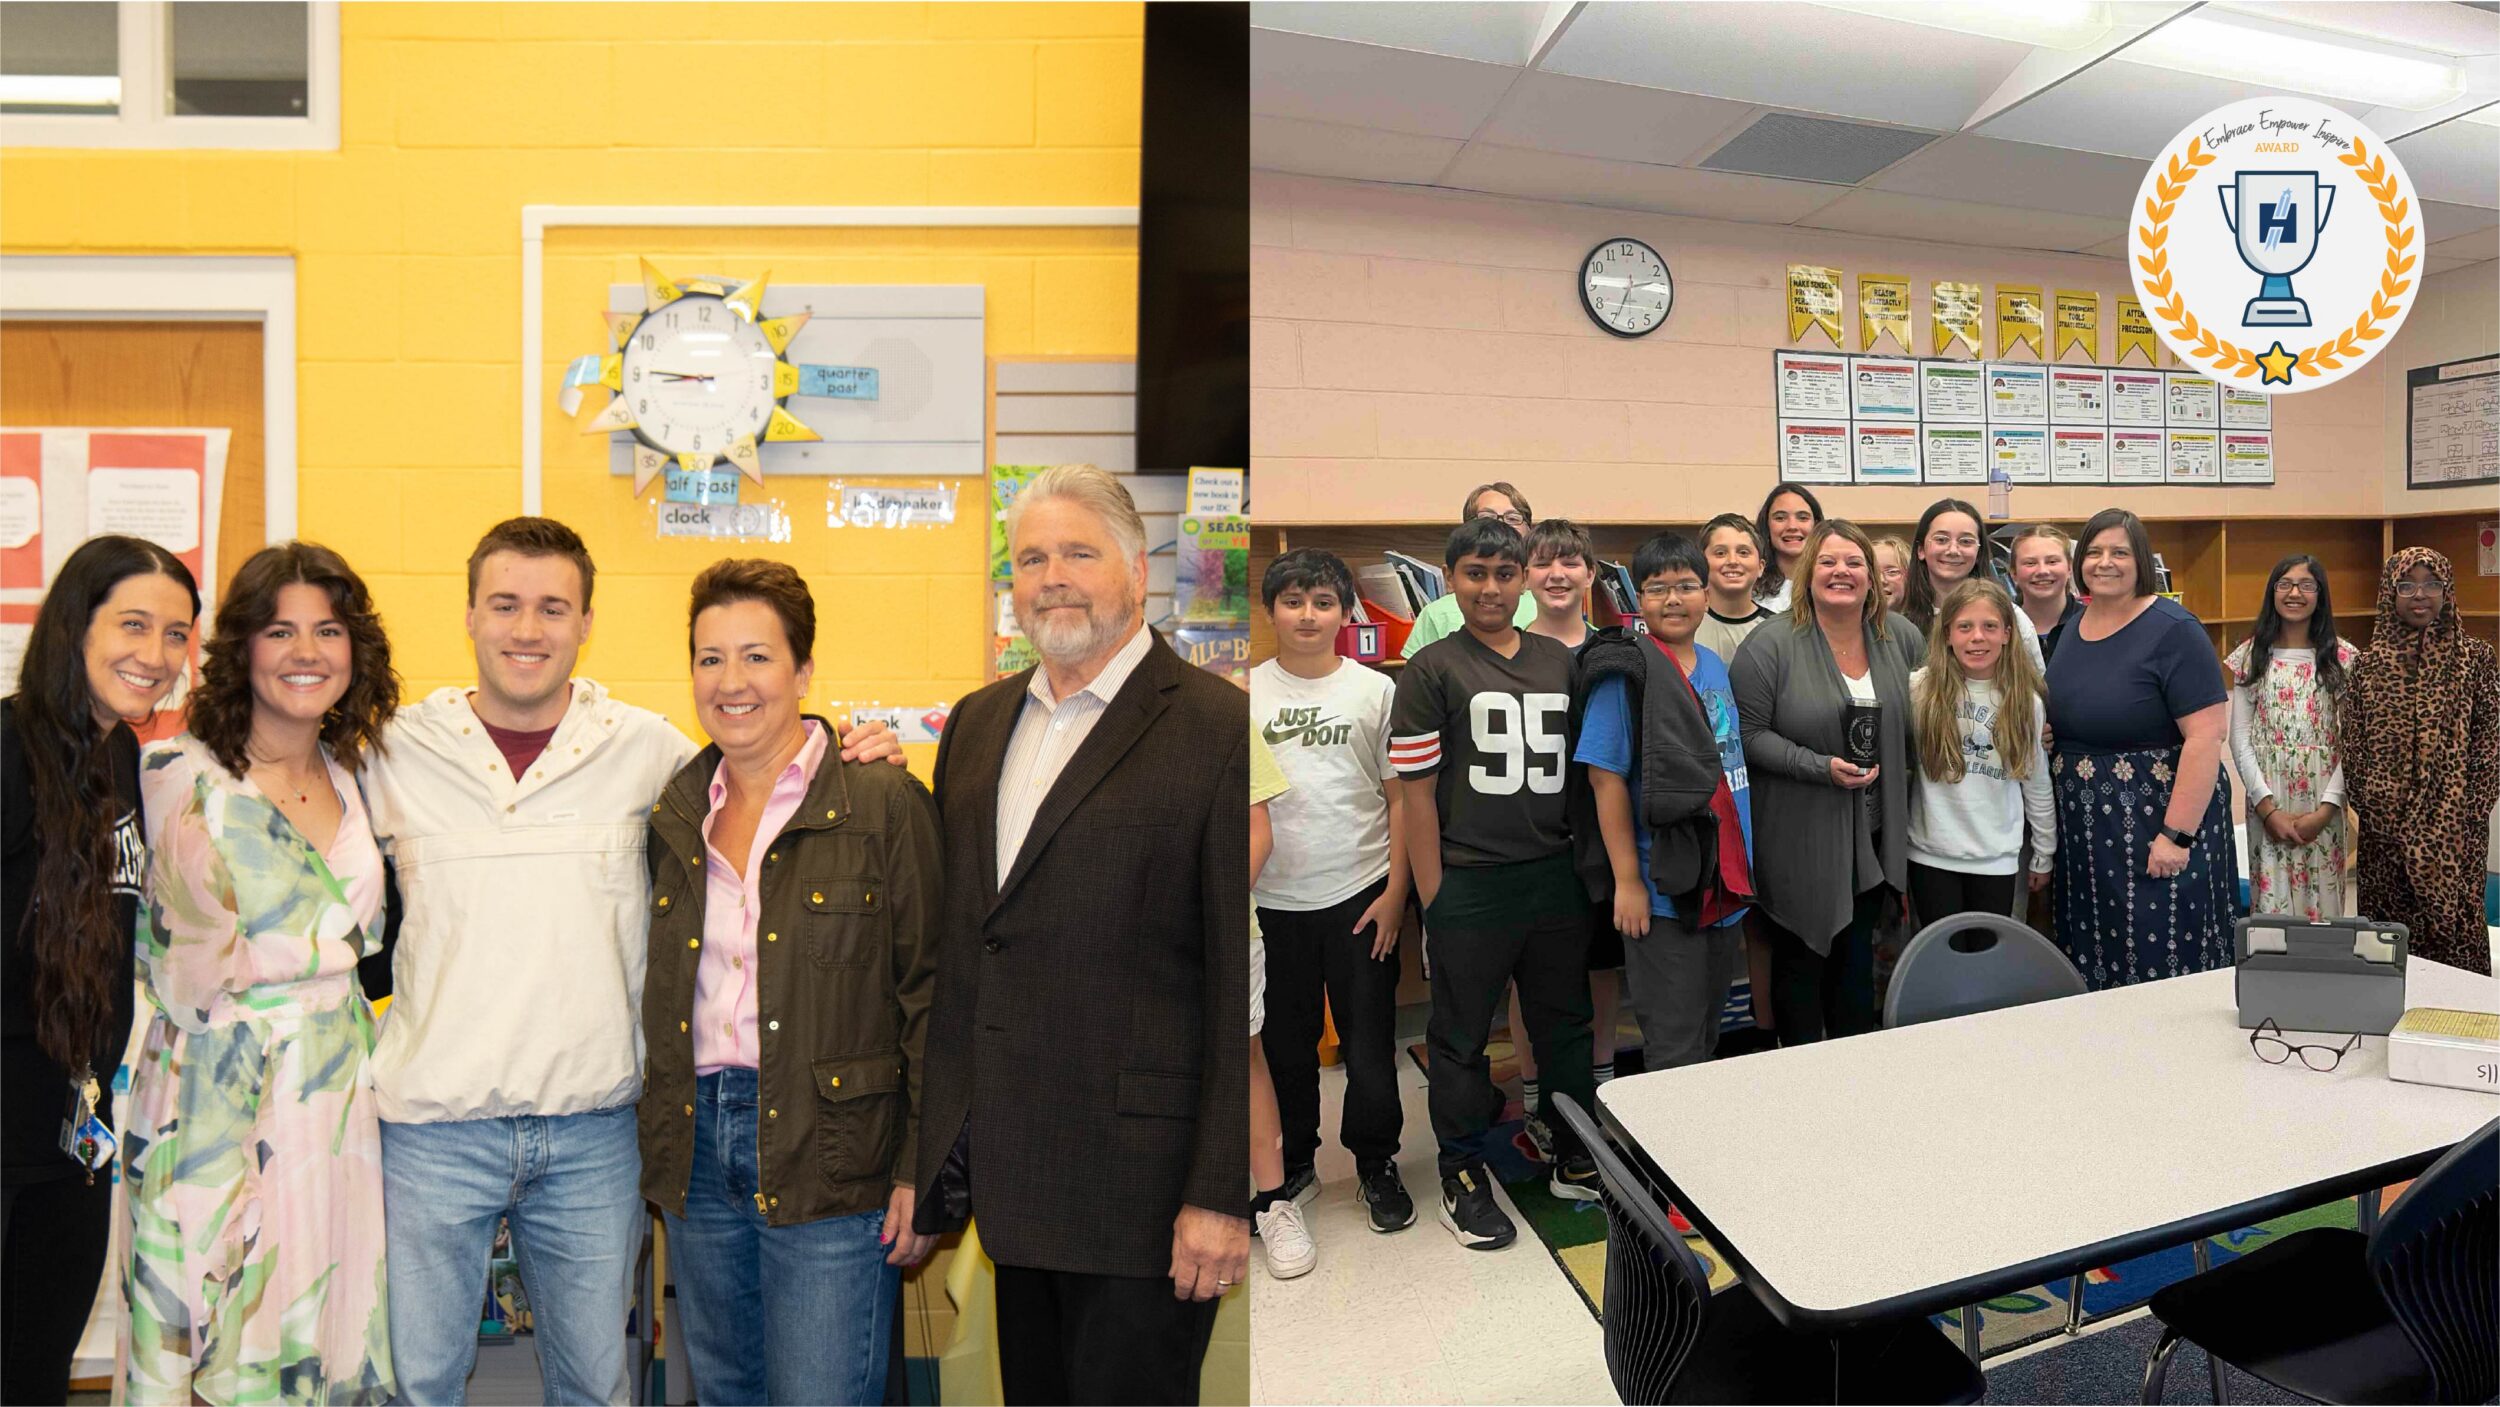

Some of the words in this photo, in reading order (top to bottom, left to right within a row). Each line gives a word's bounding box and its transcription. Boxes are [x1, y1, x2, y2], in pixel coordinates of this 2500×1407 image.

[1606, 249, 1616, 261] 11
[1621, 244, 1633, 256] 12
[1641, 251, 1646, 263] 1
[1591, 261, 1603, 273] 10
[1653, 265, 1661, 277] 2
[1793, 280, 1810, 288] MAKE
[1873, 288, 1896, 297] REASON
[1596, 297, 1604, 309] 8
[698, 306, 712, 323] 12
[1611, 312, 1618, 324] 7
[1643, 314, 1651, 326] 5
[2069, 313, 2085, 321] TOOLS
[2126, 309, 2147, 318] ATTEN
[665, 313, 679, 329] 11
[1627, 318, 1635, 330] 6
[2122, 325, 2153, 334] PRECISION
[640, 334, 654, 351] 10
[632, 366, 641, 383] 9
[817, 369, 871, 381] quarter
[761, 375, 769, 391] 3
[827, 383, 858, 395] past
[639, 400, 647, 414] 8
[750, 407, 758, 421] 4
[662, 424, 670, 440] 7
[726, 428, 733, 444] 5
[693, 434, 701, 450] 6
[696, 478, 737, 496] past
[1195, 477, 1218, 485] Check
[1211, 490, 1229, 498] book
[853, 496, 944, 511] ldspeaker
[665, 509, 711, 524] clock
[1638, 623, 1646, 635] 6
[1365, 634, 1371, 651] 1
[1188, 639, 1220, 668] ALL
[856, 716, 900, 730] bok
[1273, 706, 1322, 727] JUST
[1302, 726, 1333, 747] DO
[1332, 724, 1352, 745] IT
[1468, 690, 1570, 795] 95
